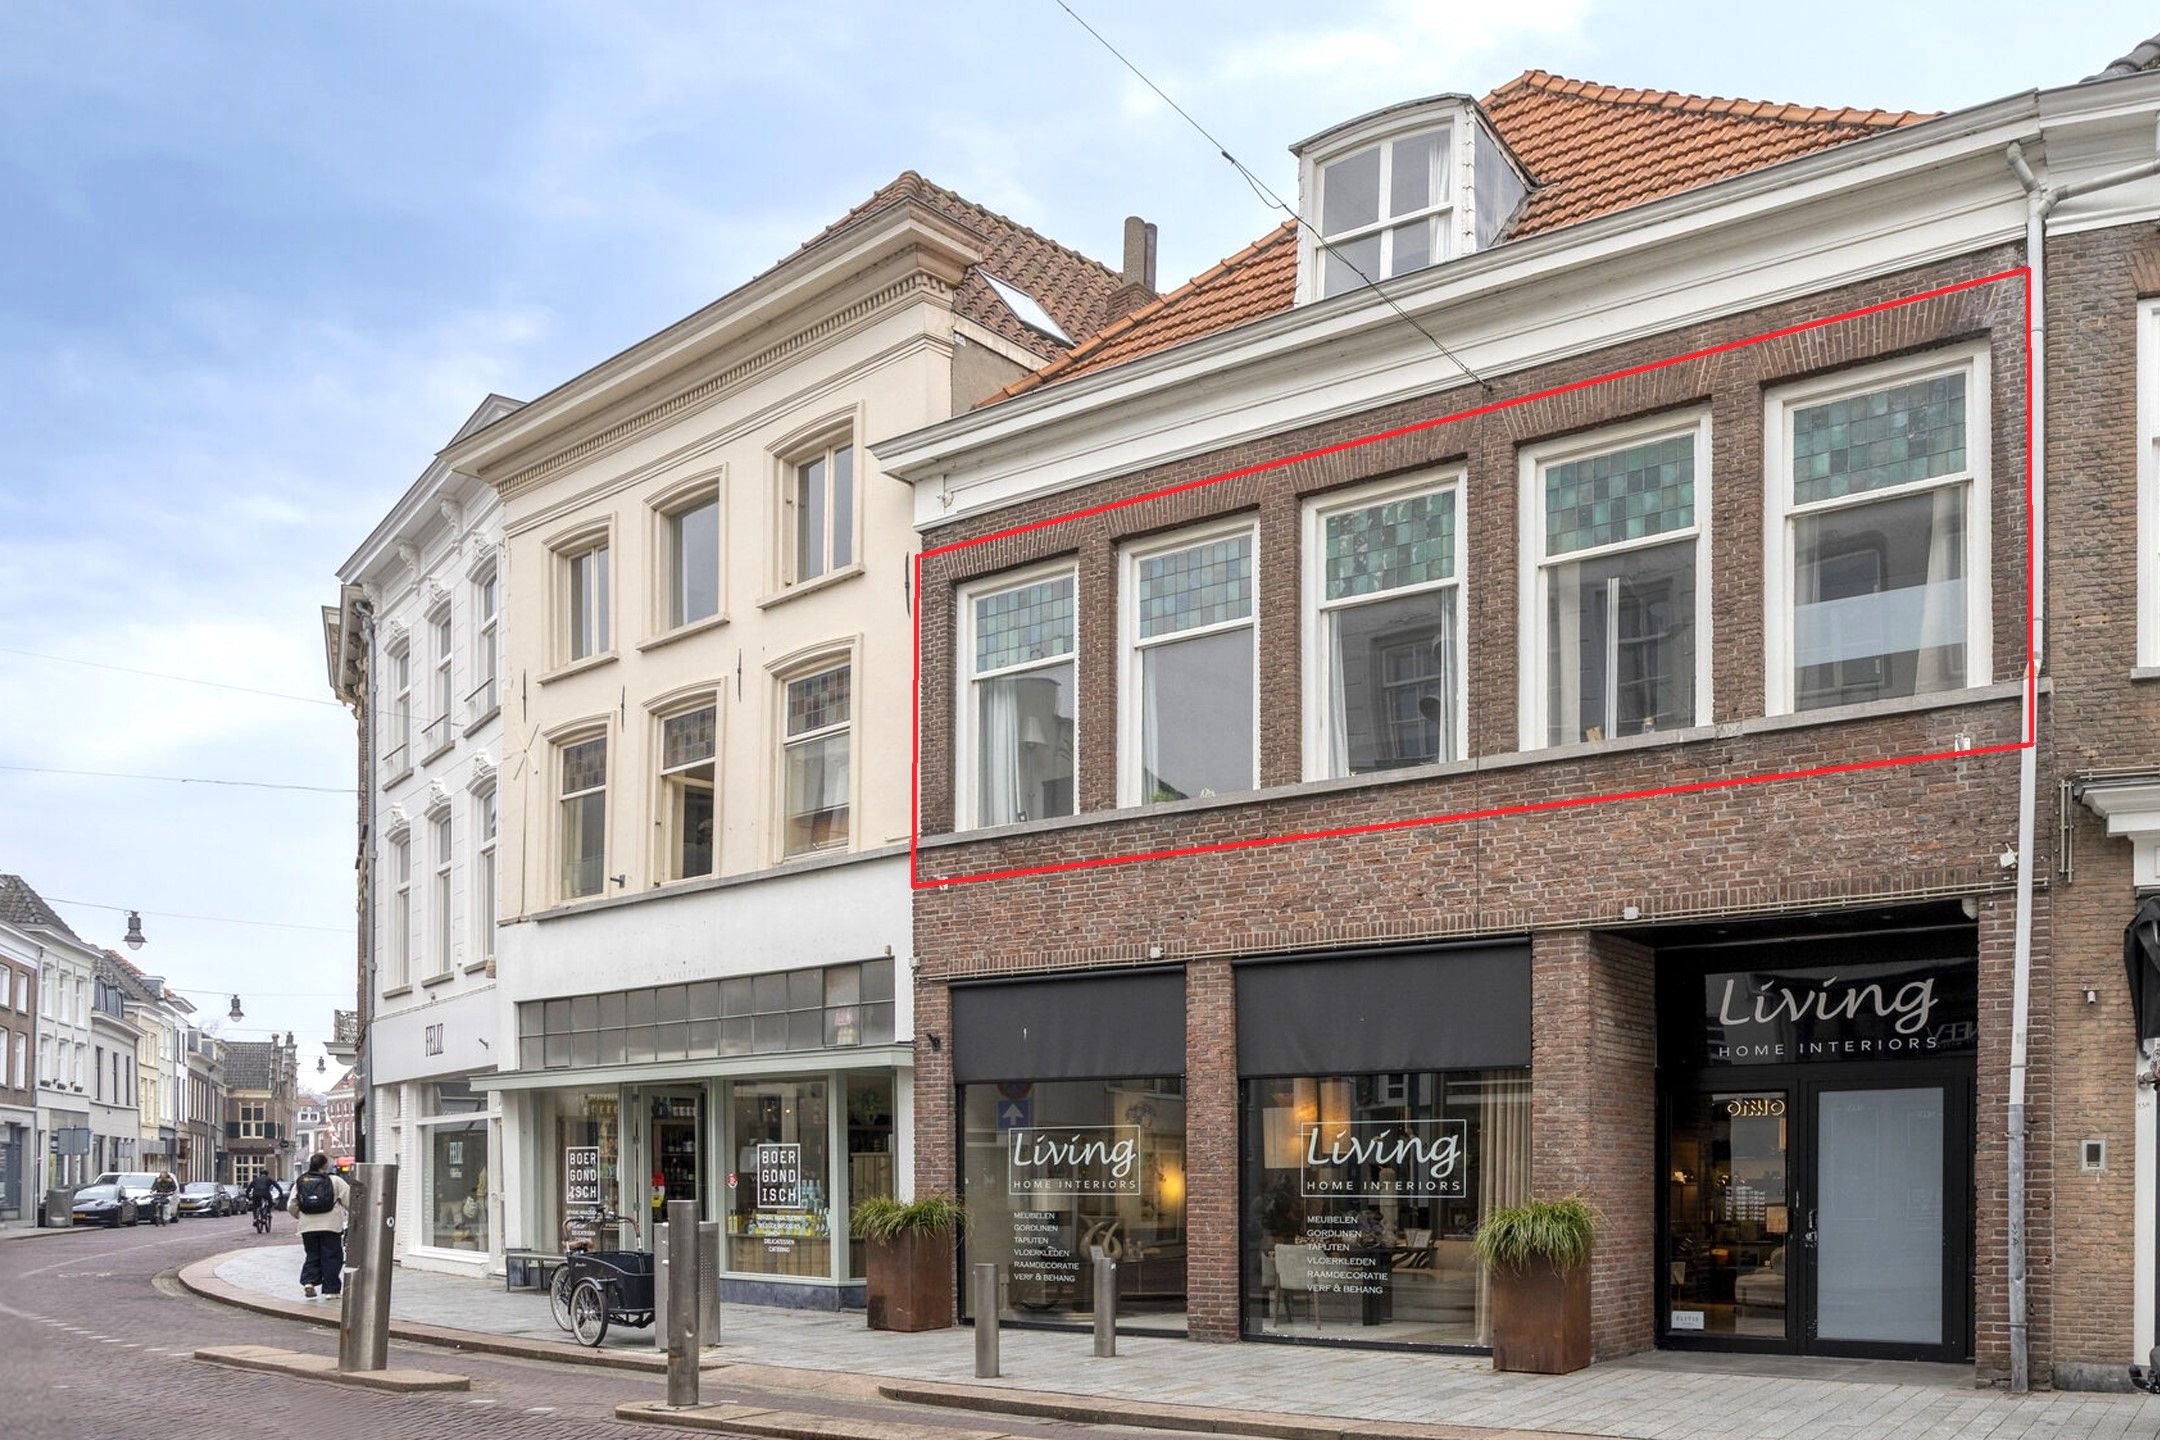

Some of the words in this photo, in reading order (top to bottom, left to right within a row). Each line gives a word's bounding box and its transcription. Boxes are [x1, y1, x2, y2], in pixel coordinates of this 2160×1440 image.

[1719, 975, 1940, 1035] Living
[425, 1023, 444, 1057] FELIZ
[1718, 1043, 1785, 1058] HOME
[1799, 1036, 1938, 1055] INTERIORS
[569, 1152, 597, 1165] BOER
[761, 1150, 797, 1164] BOER
[1013, 1132, 1137, 1179] Living
[1307, 1127, 1462, 1179] Living
[569, 1169, 597, 1182] GOND
[761, 1169, 797, 1183] GOND
[1013, 1180, 1052, 1189] HOME
[1058, 1180, 1137, 1190] INTERIORS
[1306, 1181, 1354, 1191] HOME
[1363, 1180, 1461, 1191] INTERIORS
[569, 1185, 597, 1199] ISCH
[761, 1188, 797, 1202] ISCH
[1013, 1212, 1056, 1220] MEUBELEN
[1306, 1215, 1359, 1224] MEUBELEN
[1306, 1229, 1362, 1238] GORDIJNEN
[1013, 1248, 1071, 1257] VLOERKLEDEN
[1013, 1260, 1080, 1270] RAAMDECORATIE
[1306, 1257, 1377, 1266] VLOERKLEDEN
[1013, 1273, 1034, 1281] VERF
[1035, 1272, 1042, 1281] &
[1043, 1274, 1076, 1283] BEHANG
[1306, 1270, 1389, 1281] RAAMDECORATIE
[1306, 1284, 1331, 1292] VERF
[1333, 1283, 1341, 1292] &
[1343, 1285, 1384, 1295] BEHANG
